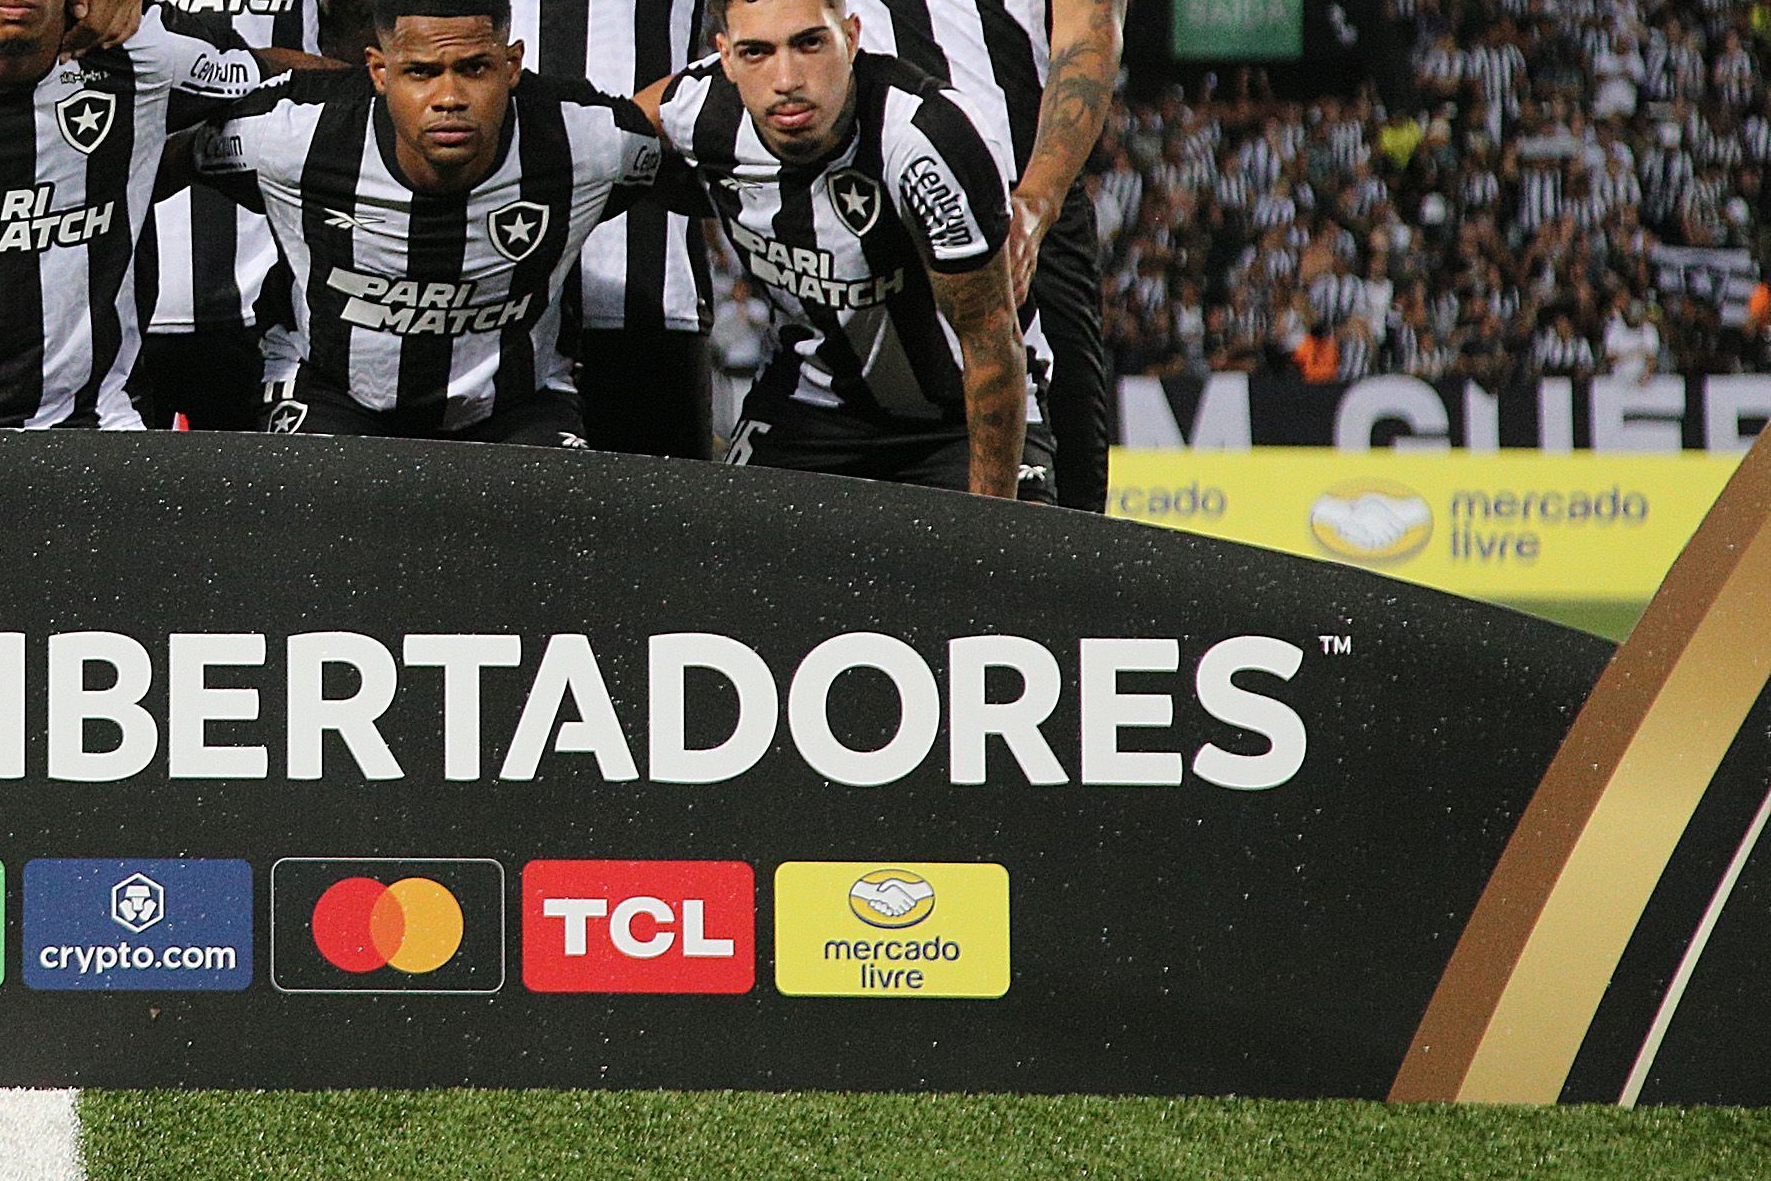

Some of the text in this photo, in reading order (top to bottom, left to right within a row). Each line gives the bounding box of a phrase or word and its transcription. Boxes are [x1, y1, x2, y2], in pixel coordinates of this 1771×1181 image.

[729, 217, 830, 280] PARI
[326, 266, 472, 309] PARI
[750, 252, 905, 309] MATCH
[340, 292, 533, 334] MATCH
[1450, 486, 1649, 521] mercado
[1450, 527, 1540, 561] livre
[543, 896, 734, 958] TCL
[39, 940, 236, 974] crypto.com
[824, 936, 961, 961] mercado
[861, 964, 925, 990] livre
